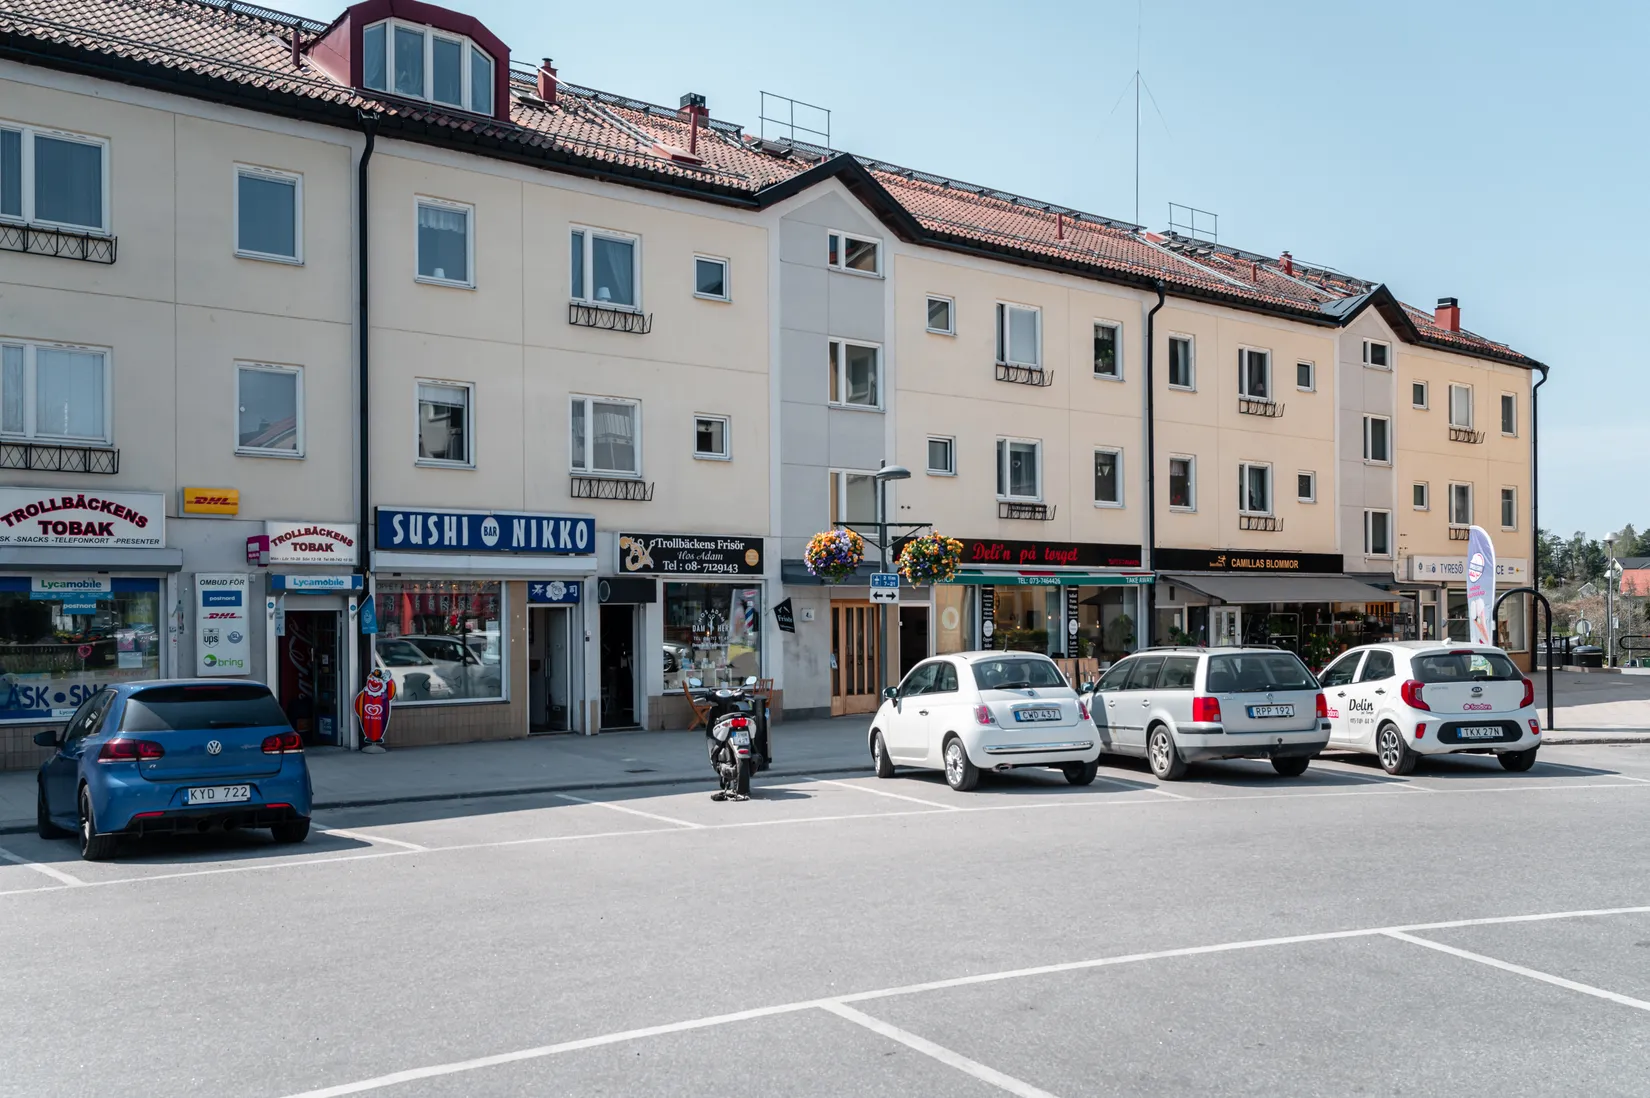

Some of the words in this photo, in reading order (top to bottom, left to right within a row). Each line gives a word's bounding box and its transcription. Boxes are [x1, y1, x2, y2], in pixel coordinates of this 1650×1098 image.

[194, 496, 231, 504] DHL
[0, 494, 149, 528] TROLLBÄCKENS
[37, 520, 115, 536] TOBAK
[392, 514, 469, 546] SUSHI
[483, 526, 498, 537] BAR
[270, 526, 354, 547] TROLLBÄCKENS
[512, 518, 588, 549] NIKKO
[291, 542, 335, 552] TOBAK
[656, 538, 715, 549] Trollbäckens
[717, 539, 745, 550] Frisör
[677, 551, 694, 560] Hos
[697, 551, 724, 560] Adam
[971, 542, 1011, 561] Deli'n
[1019, 544, 1037, 564] på
[1045, 548, 1078, 565] torget
[663, 561, 677, 570] Tel
[685, 561, 701, 571] 08-
[703, 563, 739, 573] 7129143
[1231, 558, 1265, 568] CAMILLAS
[1266, 559, 1299, 569] BLOMMOR
[1440, 561, 1463, 574] TYRESÖ
[41, 579, 102, 589] Lycamobile
[229, 578, 245, 586] FÖR
[293, 578, 344, 587] Lycamobile
[1029, 577, 1061, 585] 073-7464426
[63, 602, 97, 610] postnord
[204, 634, 219, 644] ups
[218, 658, 243, 668] bring
[1348, 698, 1374, 712] Delin
[1022, 711, 1039, 719] CWD
[1041, 710, 1057, 718] 437
[1256, 708, 1271, 716] RPP
[1275, 706, 1290, 715] 192
[1463, 728, 1481, 736] TKX
[1483, 727, 1500, 735] 27N
[190, 789, 214, 800] KYD
[224, 787, 248, 798] 722
